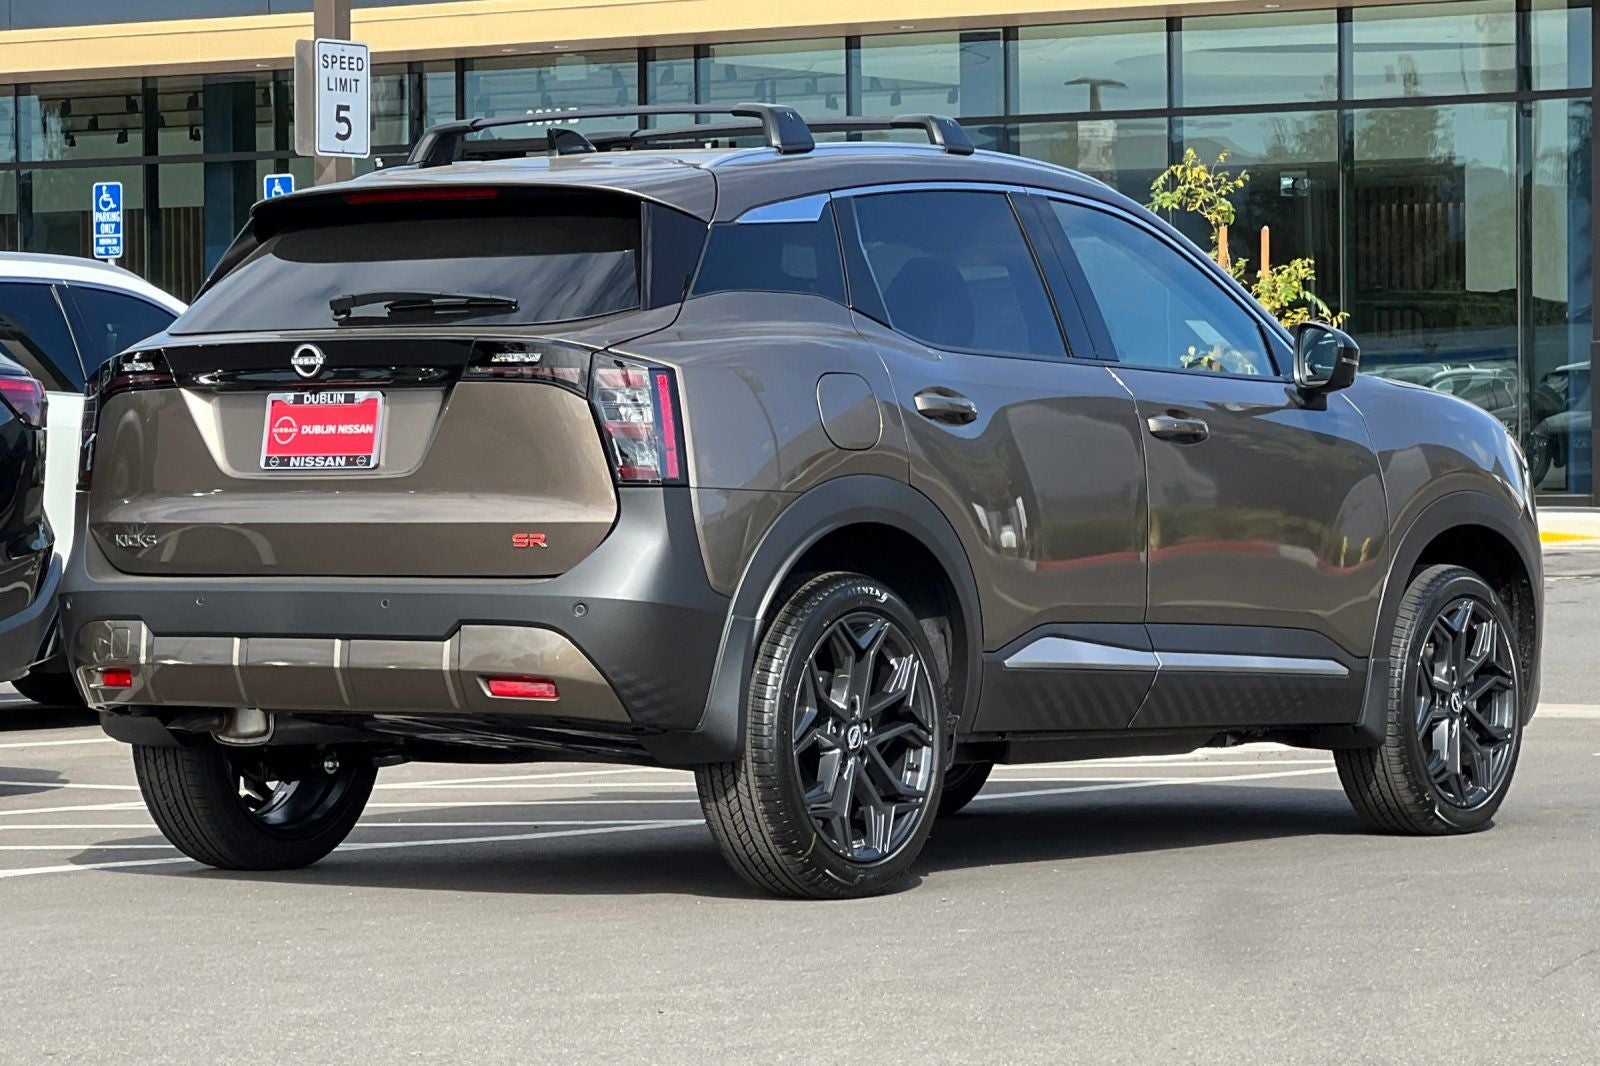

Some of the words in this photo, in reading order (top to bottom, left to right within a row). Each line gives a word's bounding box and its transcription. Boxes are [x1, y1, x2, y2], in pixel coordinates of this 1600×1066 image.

[322, 53, 364, 72] SPEED
[327, 77, 360, 93] LIMIT
[335, 104, 352, 141] 5
[95, 211, 120, 223] PARKING
[100, 223, 116, 234] ONLY
[291, 357, 323, 365] NISSAN
[303, 393, 345, 404] DUBLIN
[301, 424, 336, 435] DUBLIN
[337, 424, 373, 434] NISSAN
[289, 456, 346, 467] NISSAN
[115, 534, 157, 547] KICKS
[511, 533, 548, 548] SR
